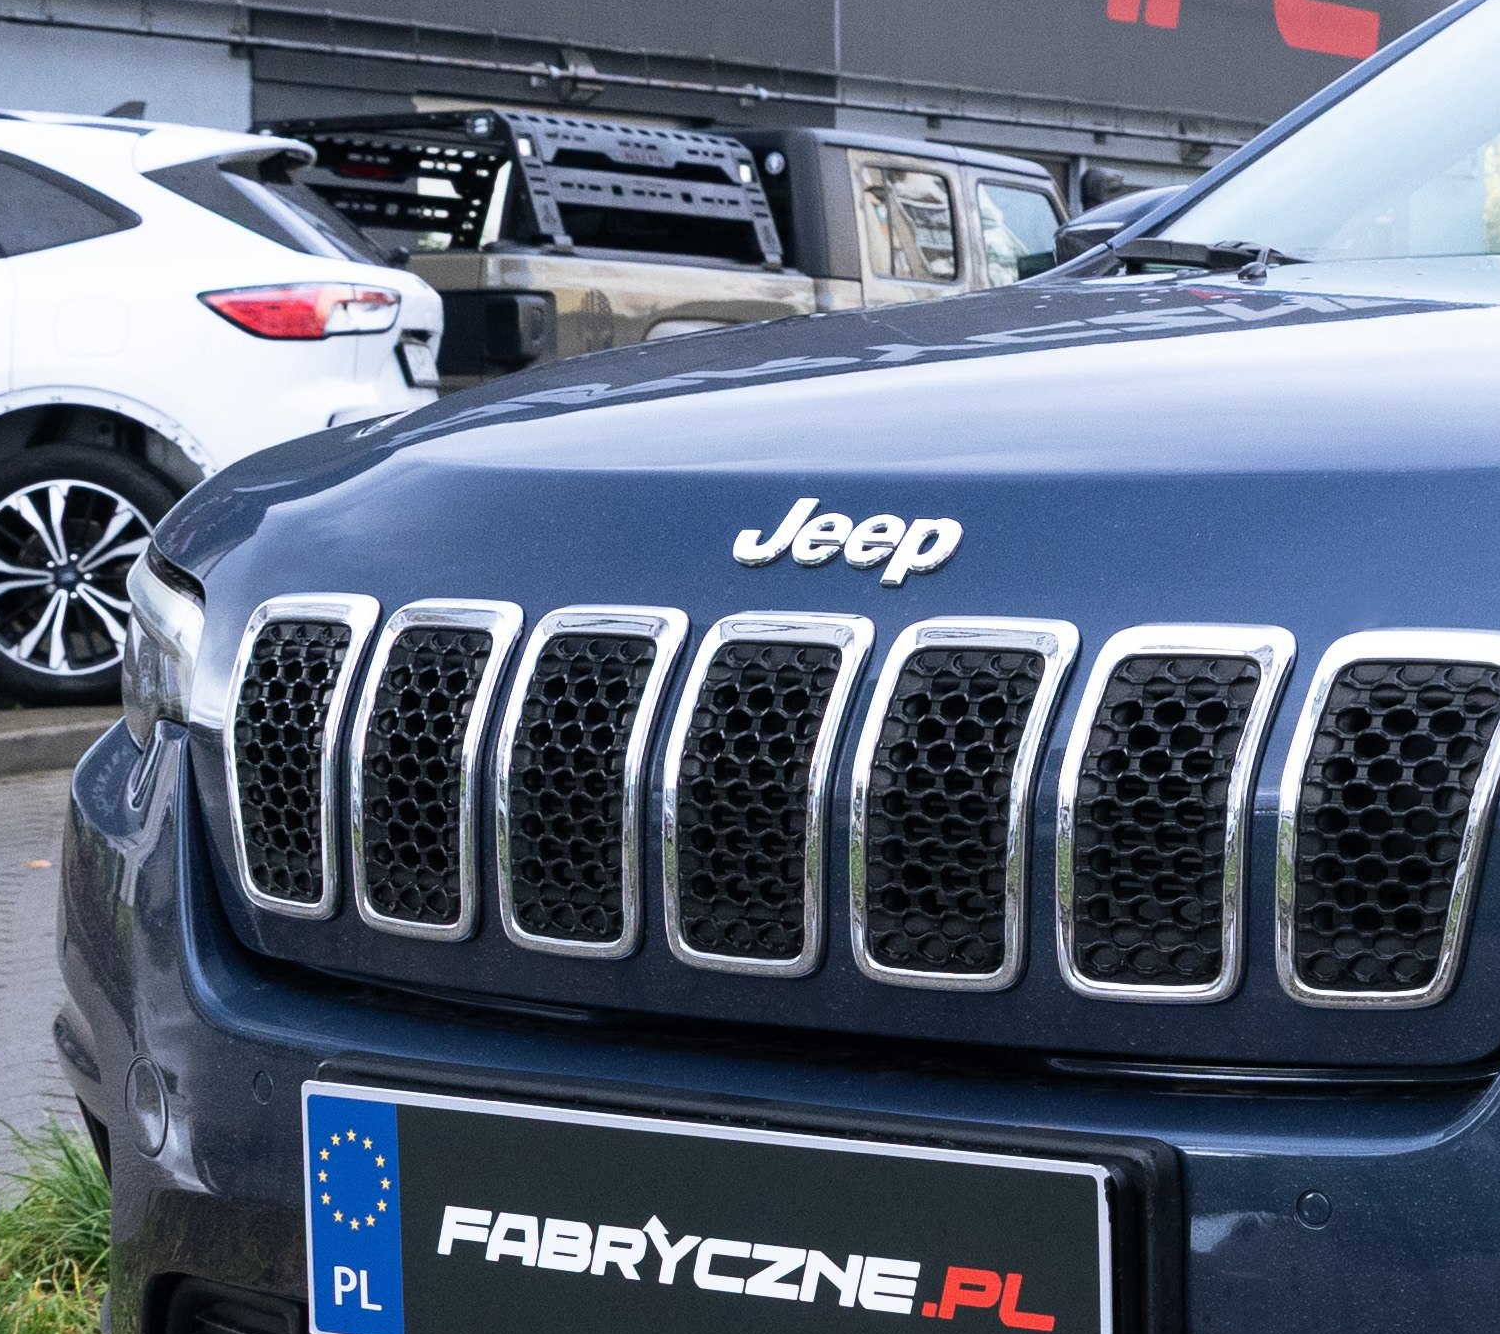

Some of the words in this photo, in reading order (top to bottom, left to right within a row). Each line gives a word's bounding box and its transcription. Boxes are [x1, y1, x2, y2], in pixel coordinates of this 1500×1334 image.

[731, 496, 964, 588] Jeep
[333, 1265, 383, 1313] PL
[436, 1205, 1057, 1334] FABRYCZNE.PL
